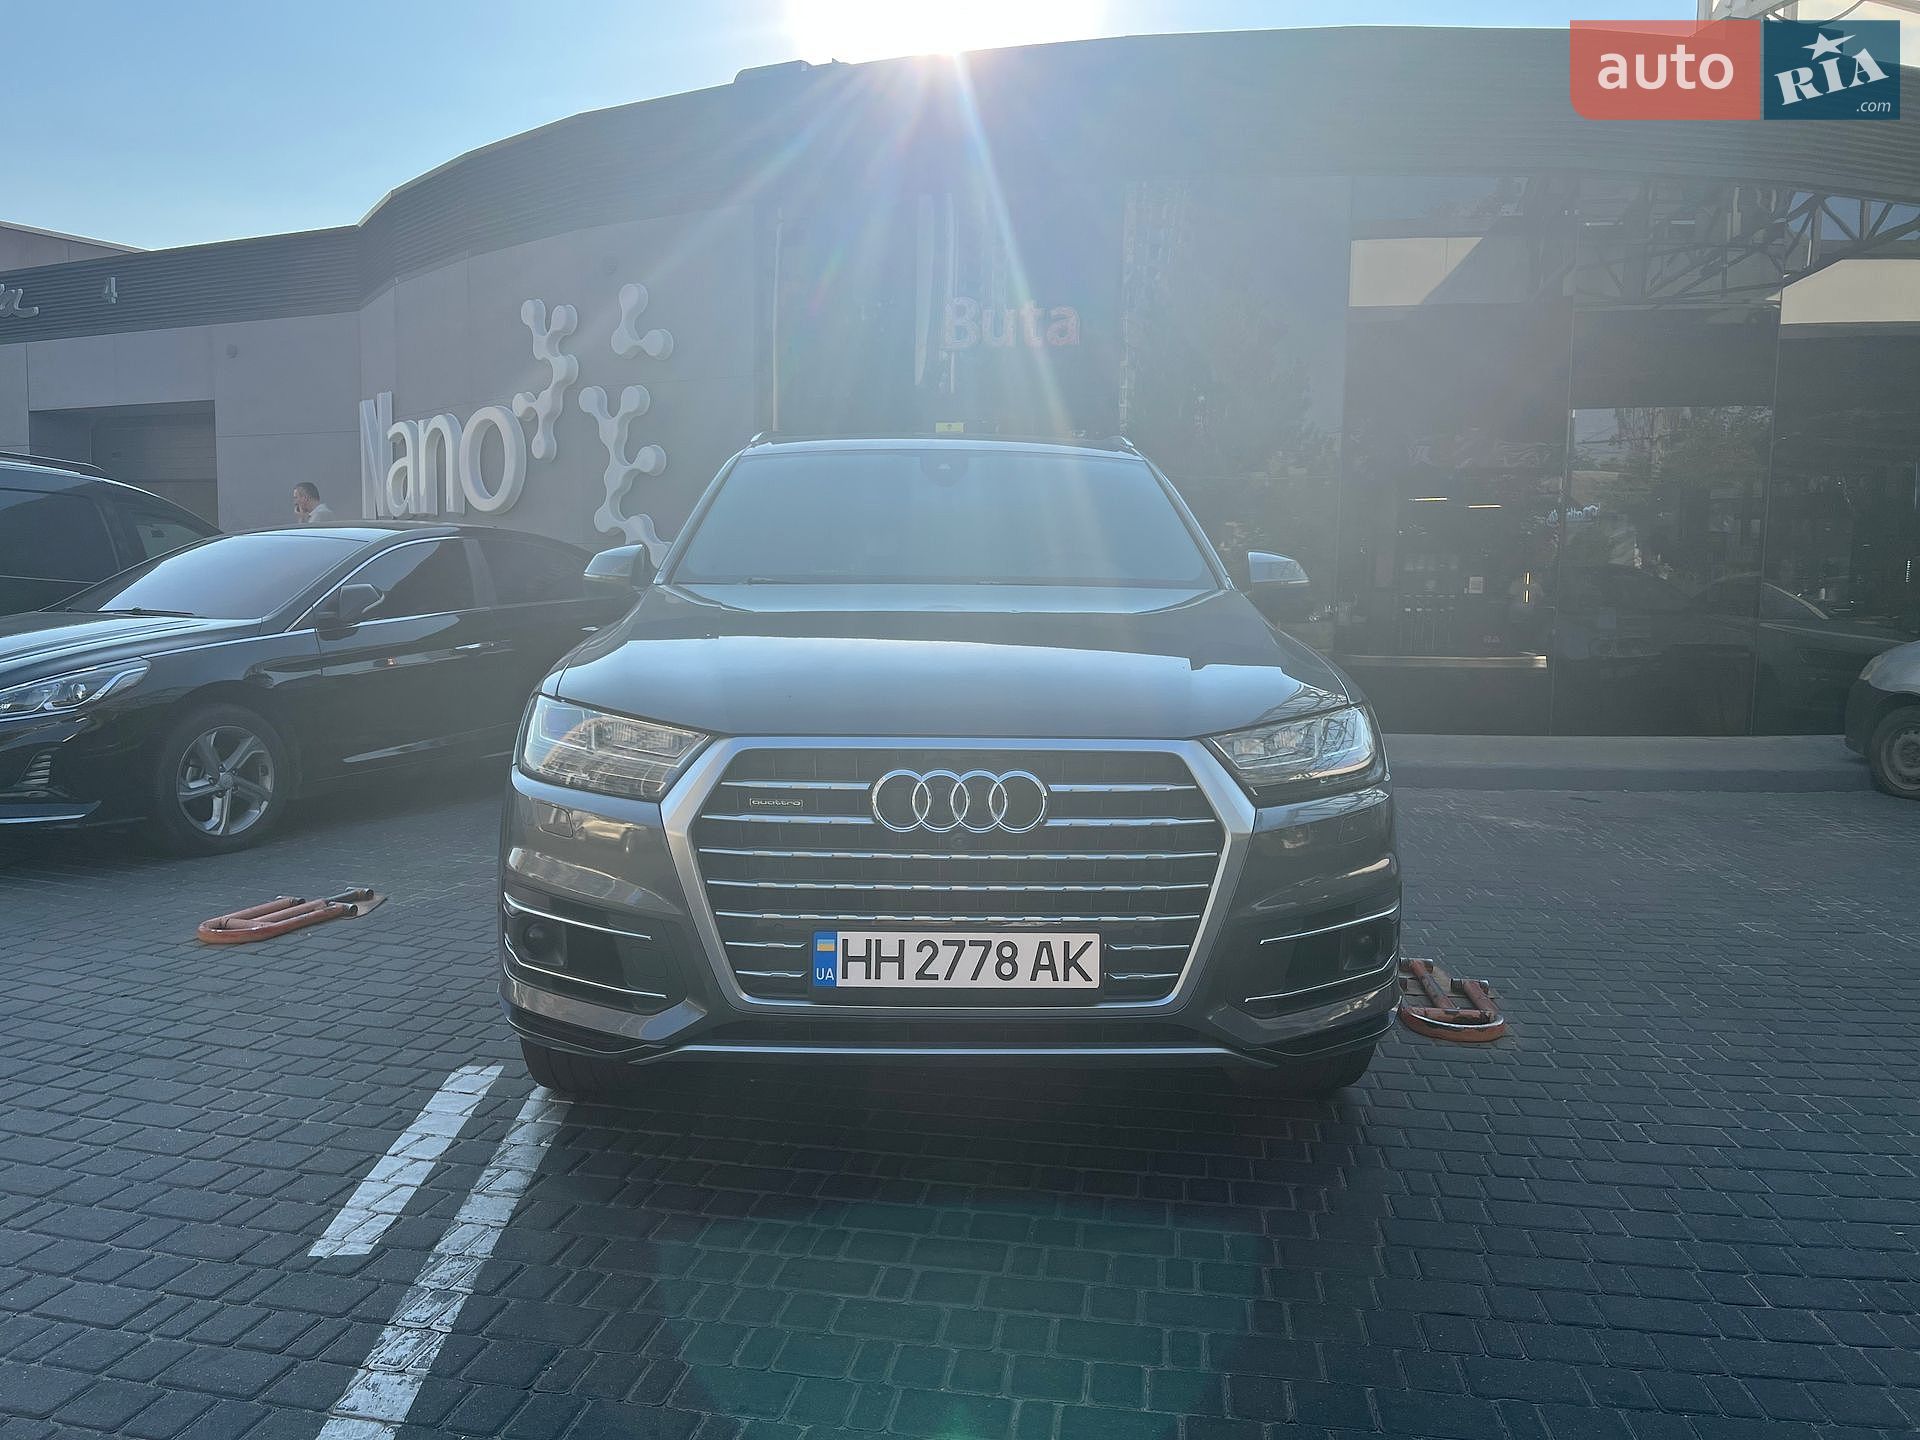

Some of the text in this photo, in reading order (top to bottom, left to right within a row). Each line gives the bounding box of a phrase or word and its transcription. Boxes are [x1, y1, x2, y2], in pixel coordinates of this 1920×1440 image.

[944, 297, 1081, 347] Buta
[359, 391, 527, 520] Nano
[816, 967, 834, 980] UA
[841, 938, 1093, 982] HH 2778 AK
